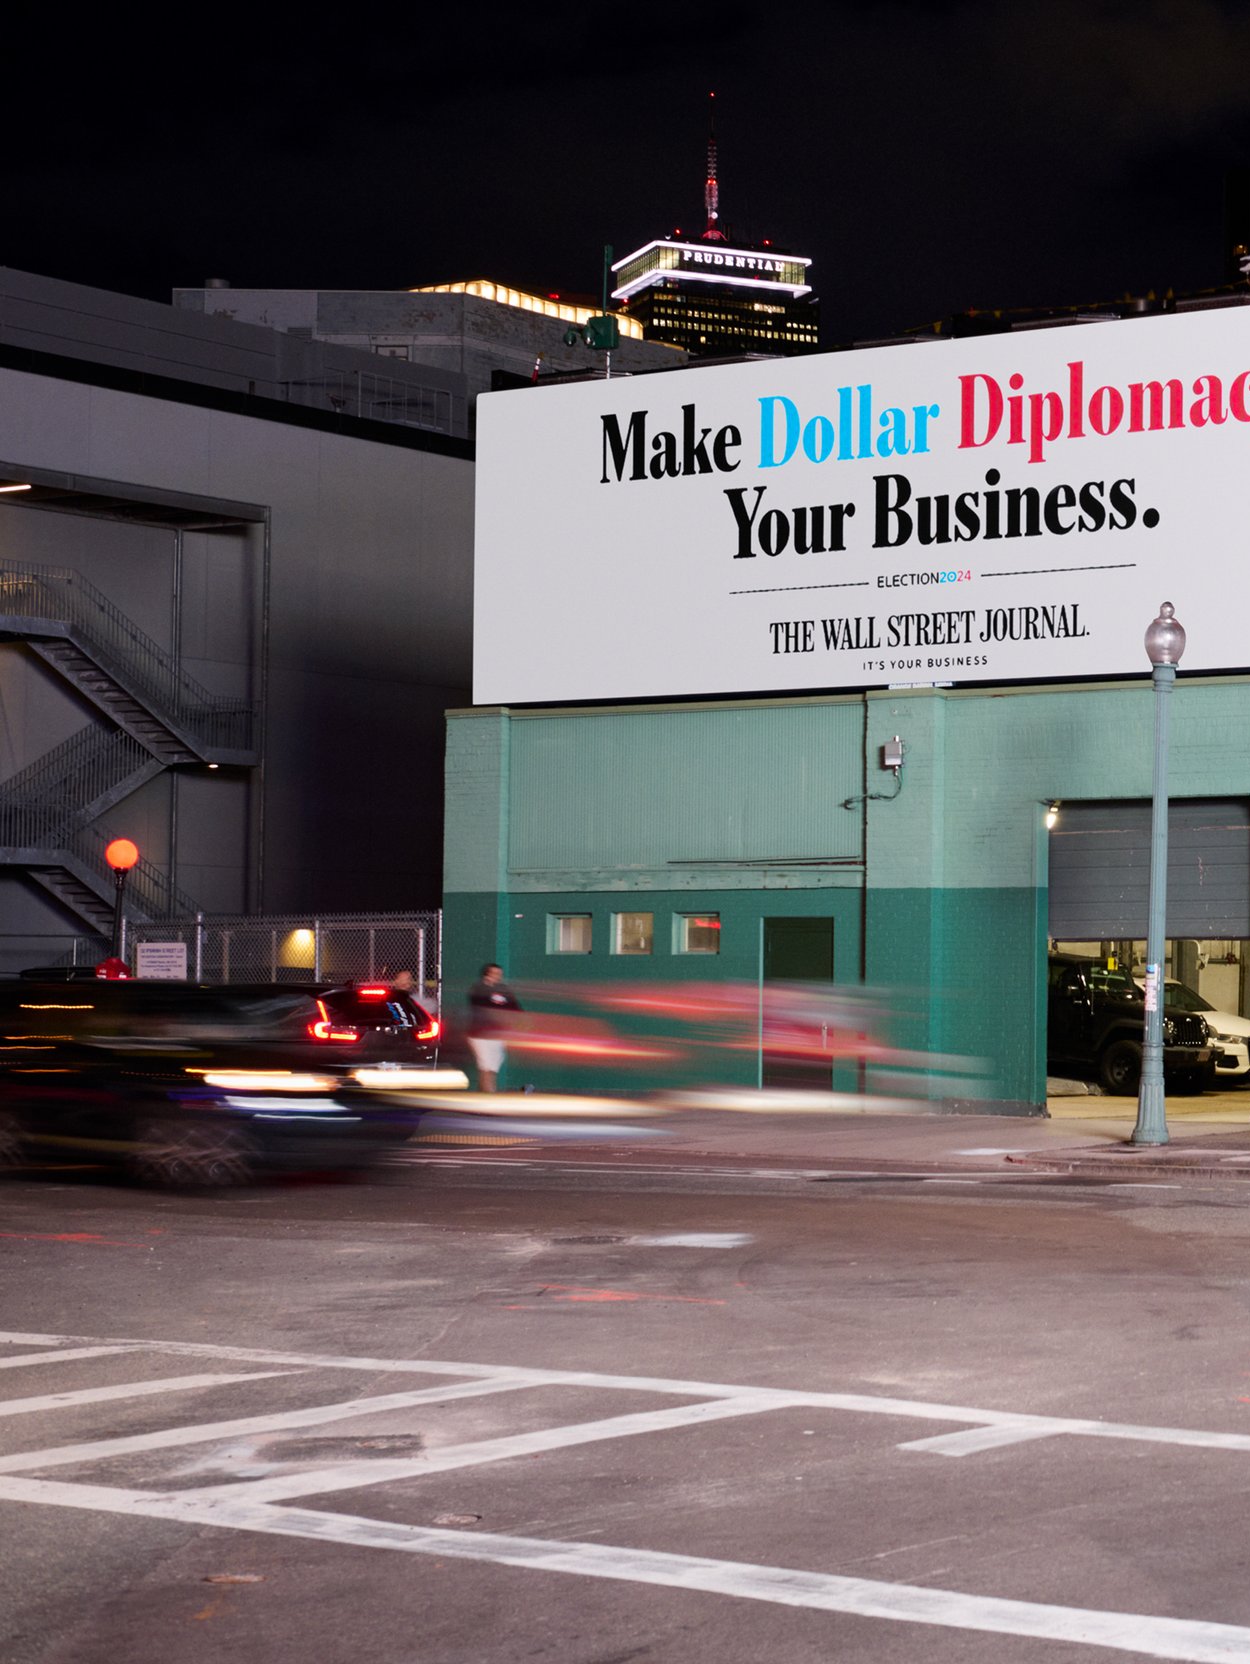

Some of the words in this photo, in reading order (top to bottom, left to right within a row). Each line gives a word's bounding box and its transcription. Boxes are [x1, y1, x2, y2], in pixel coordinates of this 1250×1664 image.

[683, 250, 785, 272] PRUDENTIAL
[600, 403, 742, 484] Make
[757, 384, 941, 469] Dollar
[722, 485, 856, 560] Your
[871, 468, 1160, 549] Business.
[876, 569, 972, 589] ELECTION2024
[769, 620, 815, 655] THE
[820, 616, 881, 651] WALL
[886, 610, 976, 648] STREET
[979, 603, 1091, 643] JOURNAL.
[862, 660, 885, 671] IT'S
[890, 658, 922, 670] YOUR
[927, 655, 988, 668] BUSINESS
